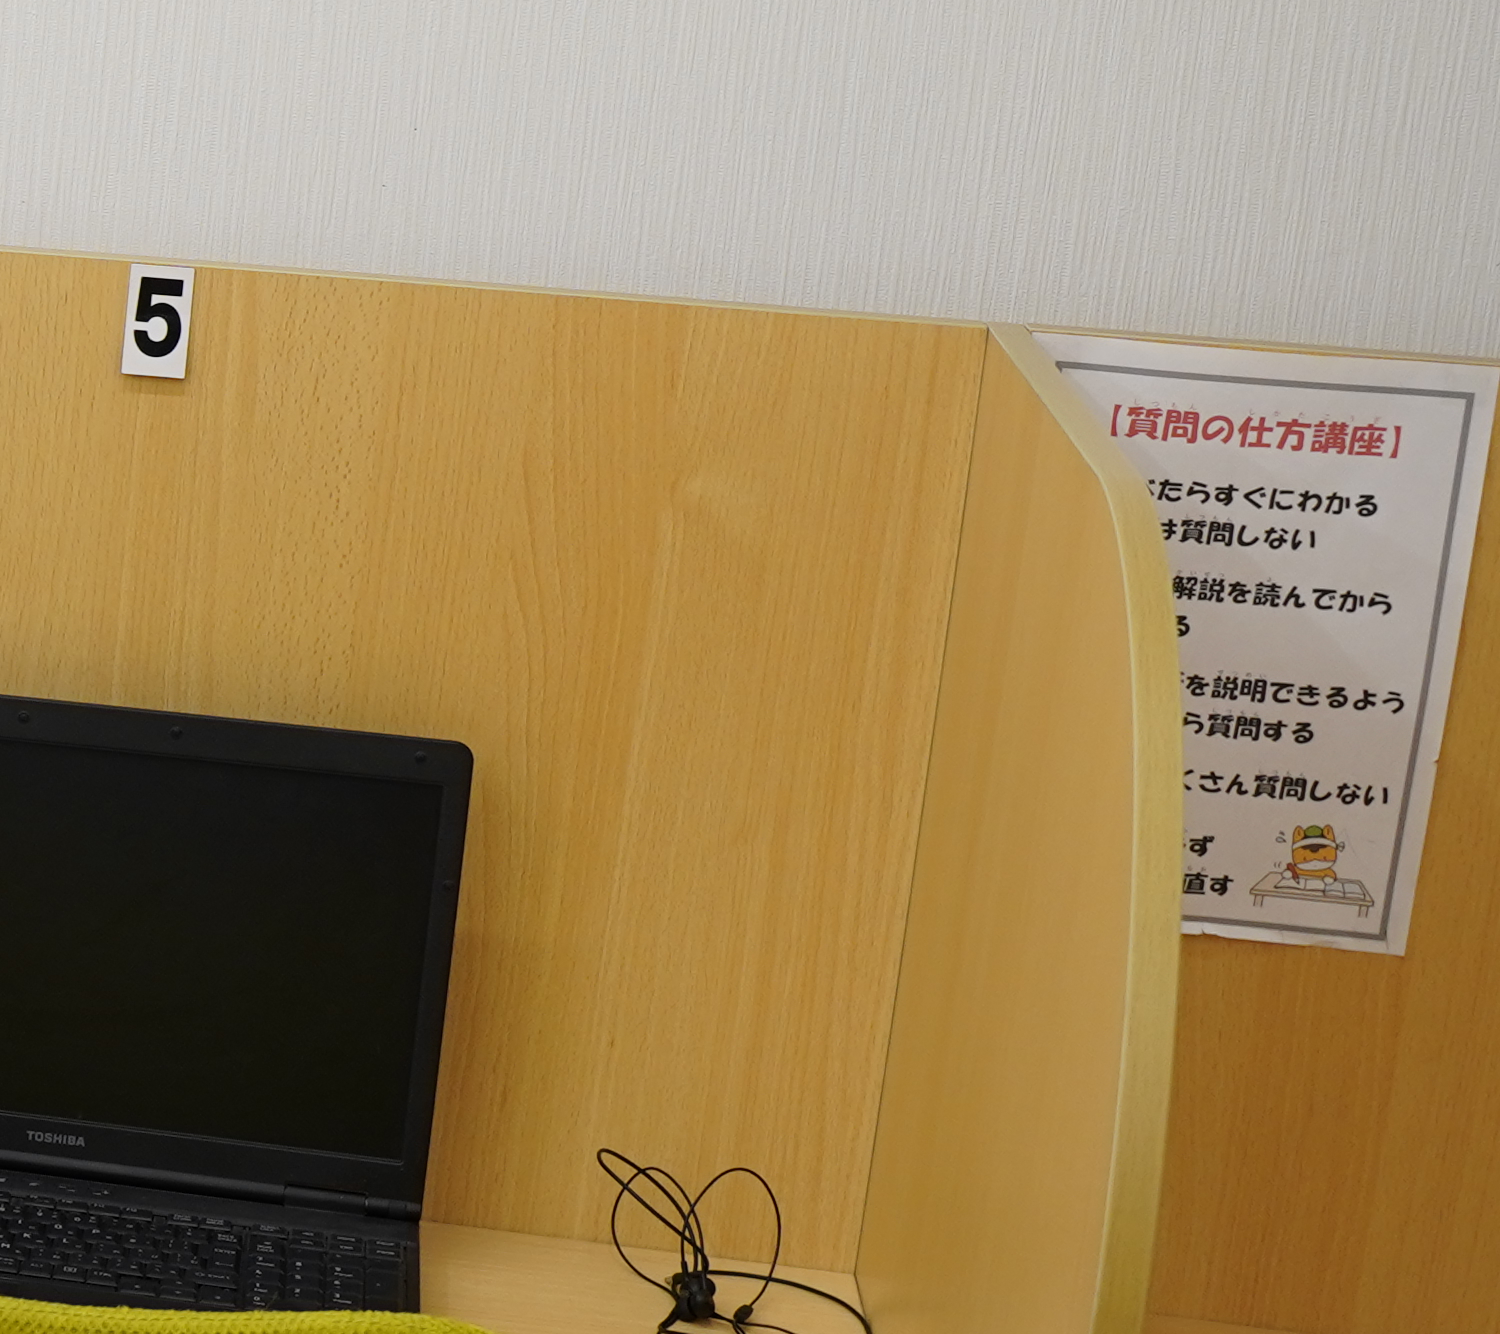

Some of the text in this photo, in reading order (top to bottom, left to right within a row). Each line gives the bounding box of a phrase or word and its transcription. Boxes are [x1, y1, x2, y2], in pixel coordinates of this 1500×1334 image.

[134, 276, 184, 358] 5
[1110, 404, 1402, 459] 【質問の仕方講座】
[1172, 575, 1393, 615] 解説を読んでから
[1180, 671, 1405, 714] を説明できるよう
[1183, 872, 1234, 896] 直す
[26, 1130, 85, 1147] TOSHIBA
